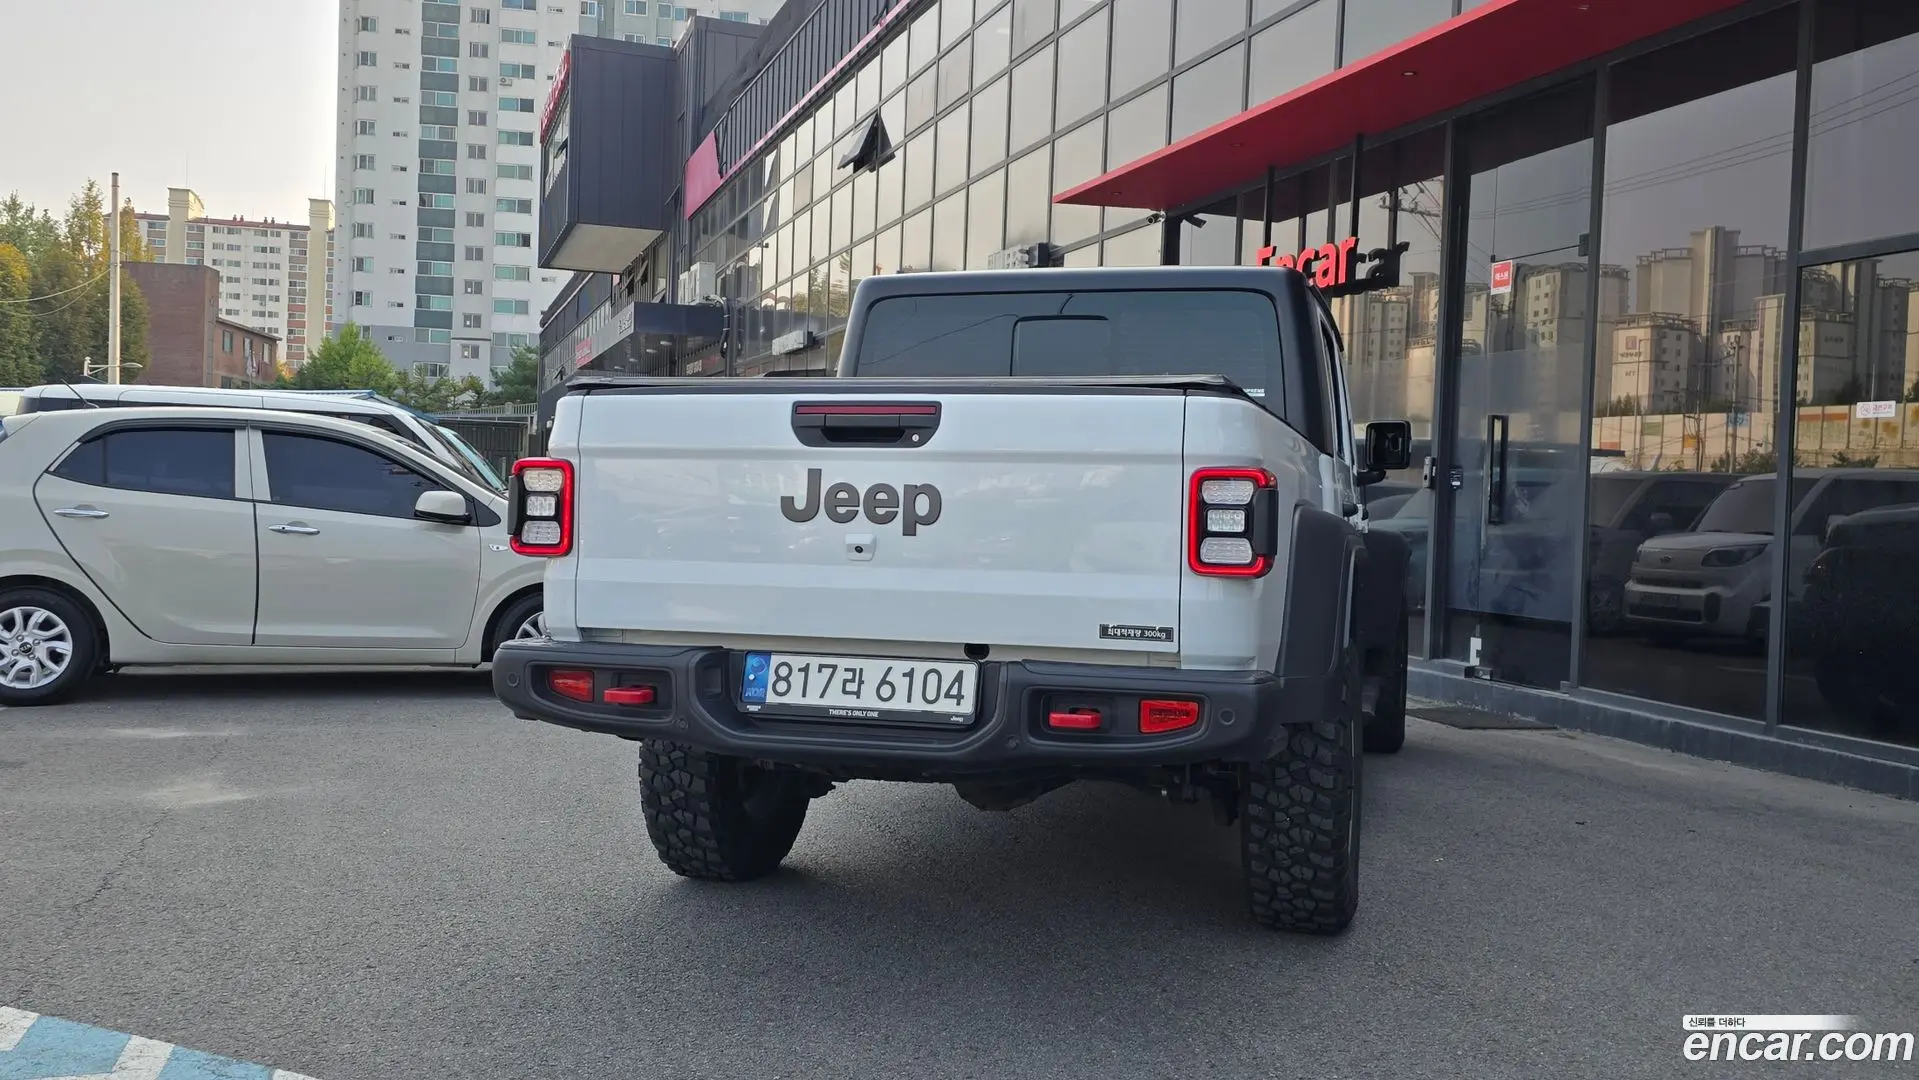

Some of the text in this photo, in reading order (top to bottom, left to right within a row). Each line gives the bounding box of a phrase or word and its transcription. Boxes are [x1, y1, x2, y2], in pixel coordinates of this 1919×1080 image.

[780, 468, 942, 536] Jeep
[1144, 630, 1165, 639] 300kg
[771, 661, 965, 706] 817라 6104
[828, 708, 879, 719] THERE'S ONLY ONE
[950, 715, 964, 723] Jeep
